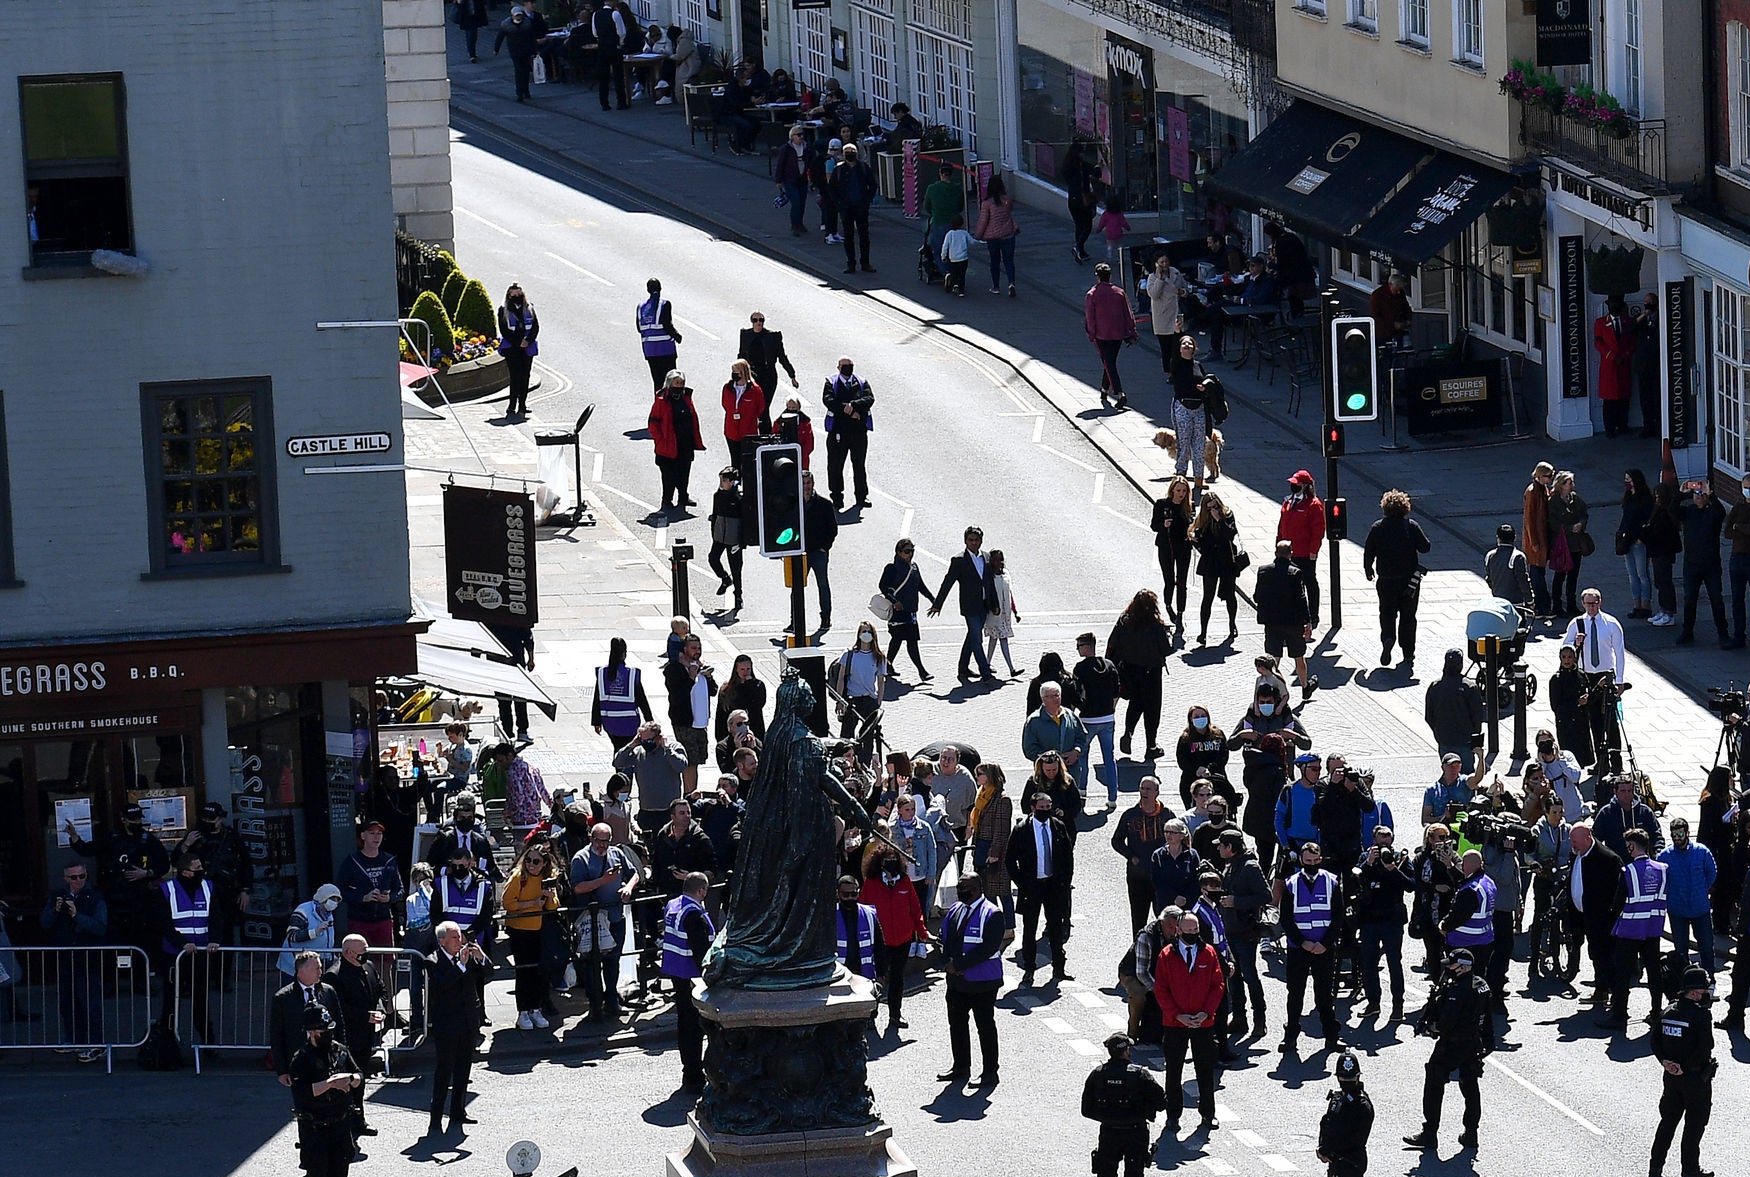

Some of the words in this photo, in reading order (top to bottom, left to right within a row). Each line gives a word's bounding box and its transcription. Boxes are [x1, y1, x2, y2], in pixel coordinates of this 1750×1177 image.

[1567, 240, 1578, 301] WINDSOR
[1672, 286, 1681, 344] WINDSOR
[1569, 302, 1581, 384] MACDONALD
[1442, 380, 1484, 391] ESQUIRES
[1448, 389, 1480, 399] COFFEE
[1672, 345, 1684, 435] MACDONALD
[290, 438, 348, 453] CASTLE
[354, 436, 388, 449] HILL
[506, 504, 528, 615] BLUEGRASS
[1, 661, 107, 696] EGRASS
[130, 665, 185, 680] B.B.Q.
[31, 720, 85, 732] SOUTHERN
[90, 715, 159, 728] SMOKEHOUSE
